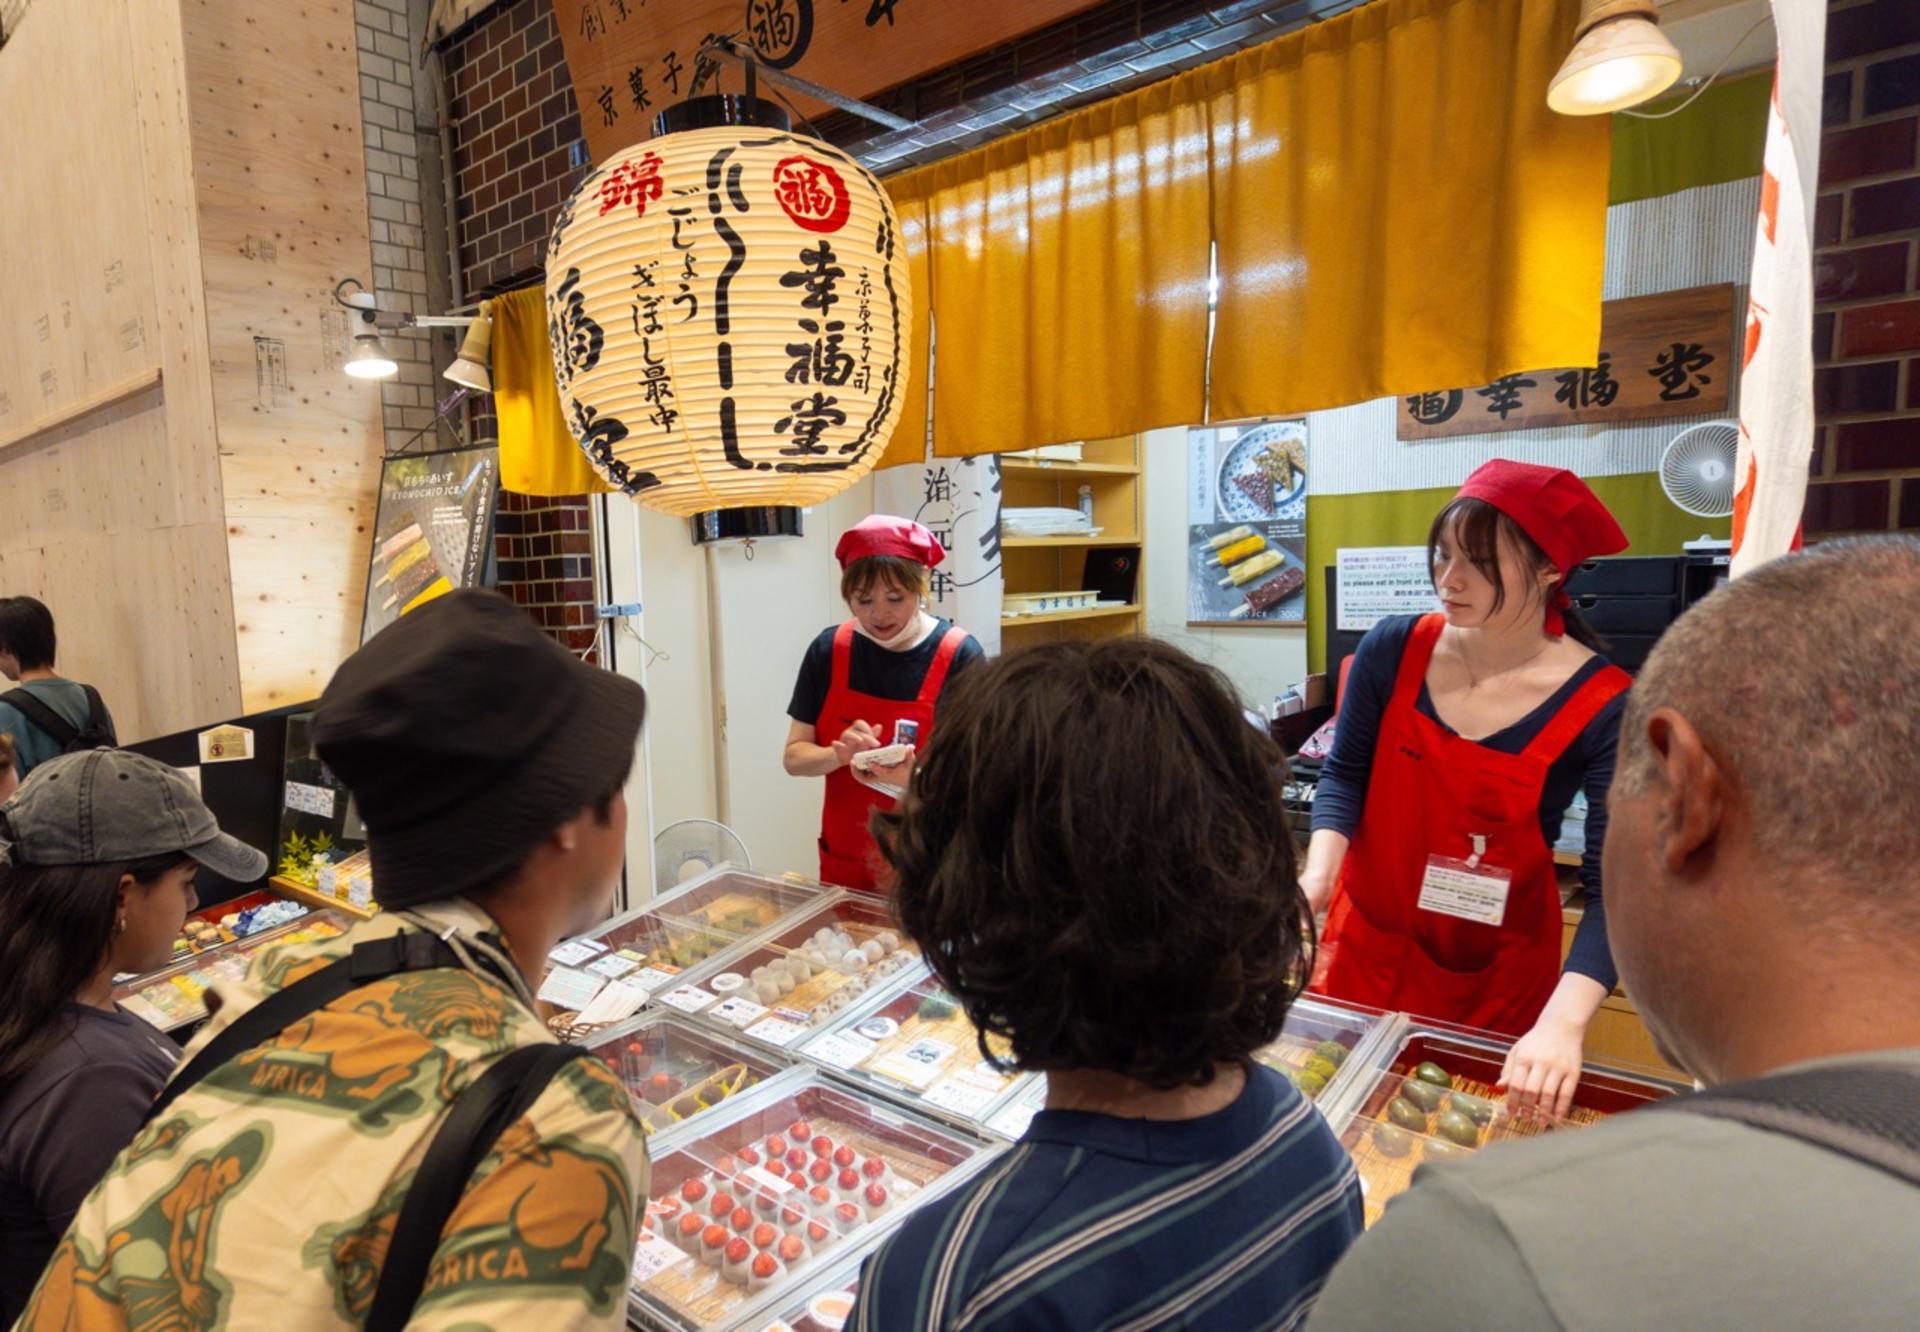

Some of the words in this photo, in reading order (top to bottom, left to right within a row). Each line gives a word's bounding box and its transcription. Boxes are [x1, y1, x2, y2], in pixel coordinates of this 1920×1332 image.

[592, 151, 664, 218] 錦
[667, 186, 700, 323] ごじょう
[631, 261, 679, 433] ぎぼし最中
[773, 240, 856, 456] 幸福堂
[1476, 343, 1716, 420] 幸福堂
[1353, 580, 1374, 588] please
[249, 1061, 327, 1100] AFRICA
